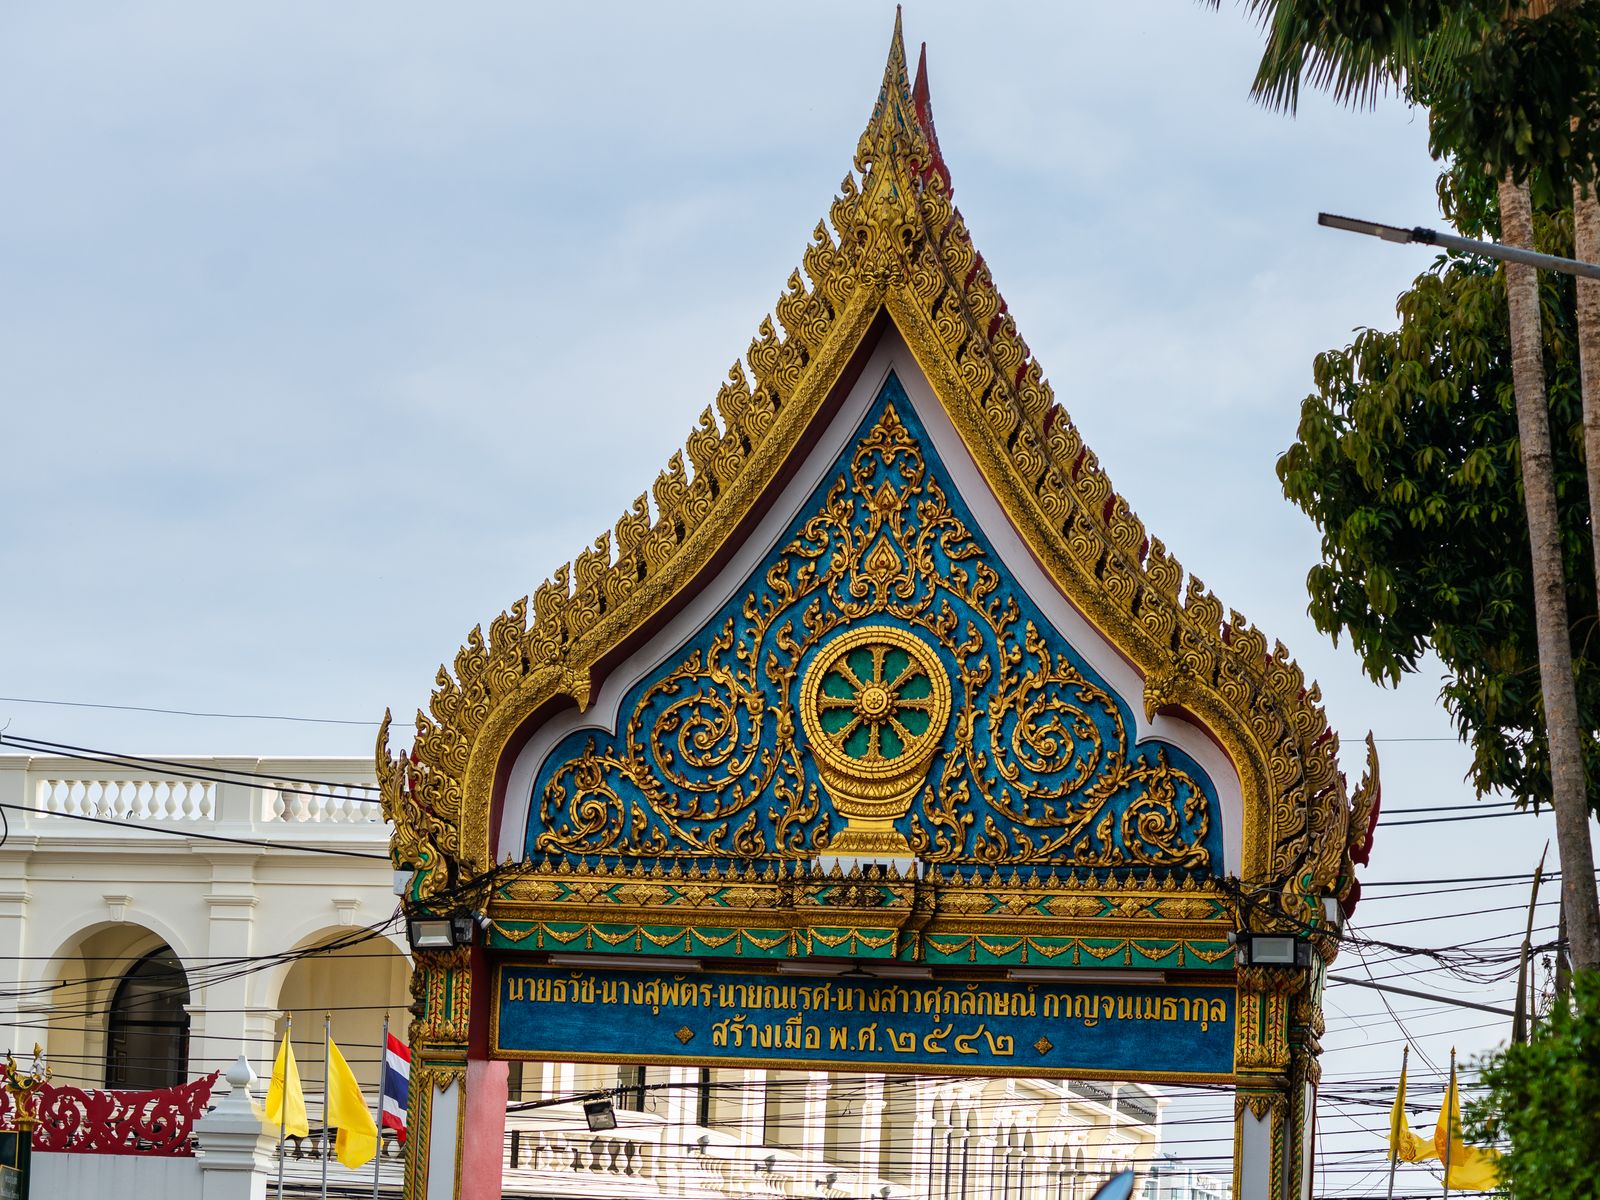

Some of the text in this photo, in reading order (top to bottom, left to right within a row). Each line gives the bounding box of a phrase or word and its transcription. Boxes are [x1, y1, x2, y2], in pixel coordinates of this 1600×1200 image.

[712, 1012, 820, 1049] สร้างเมื่อ
[1043, 993, 1227, 1032] กาญจนเมธากุล
